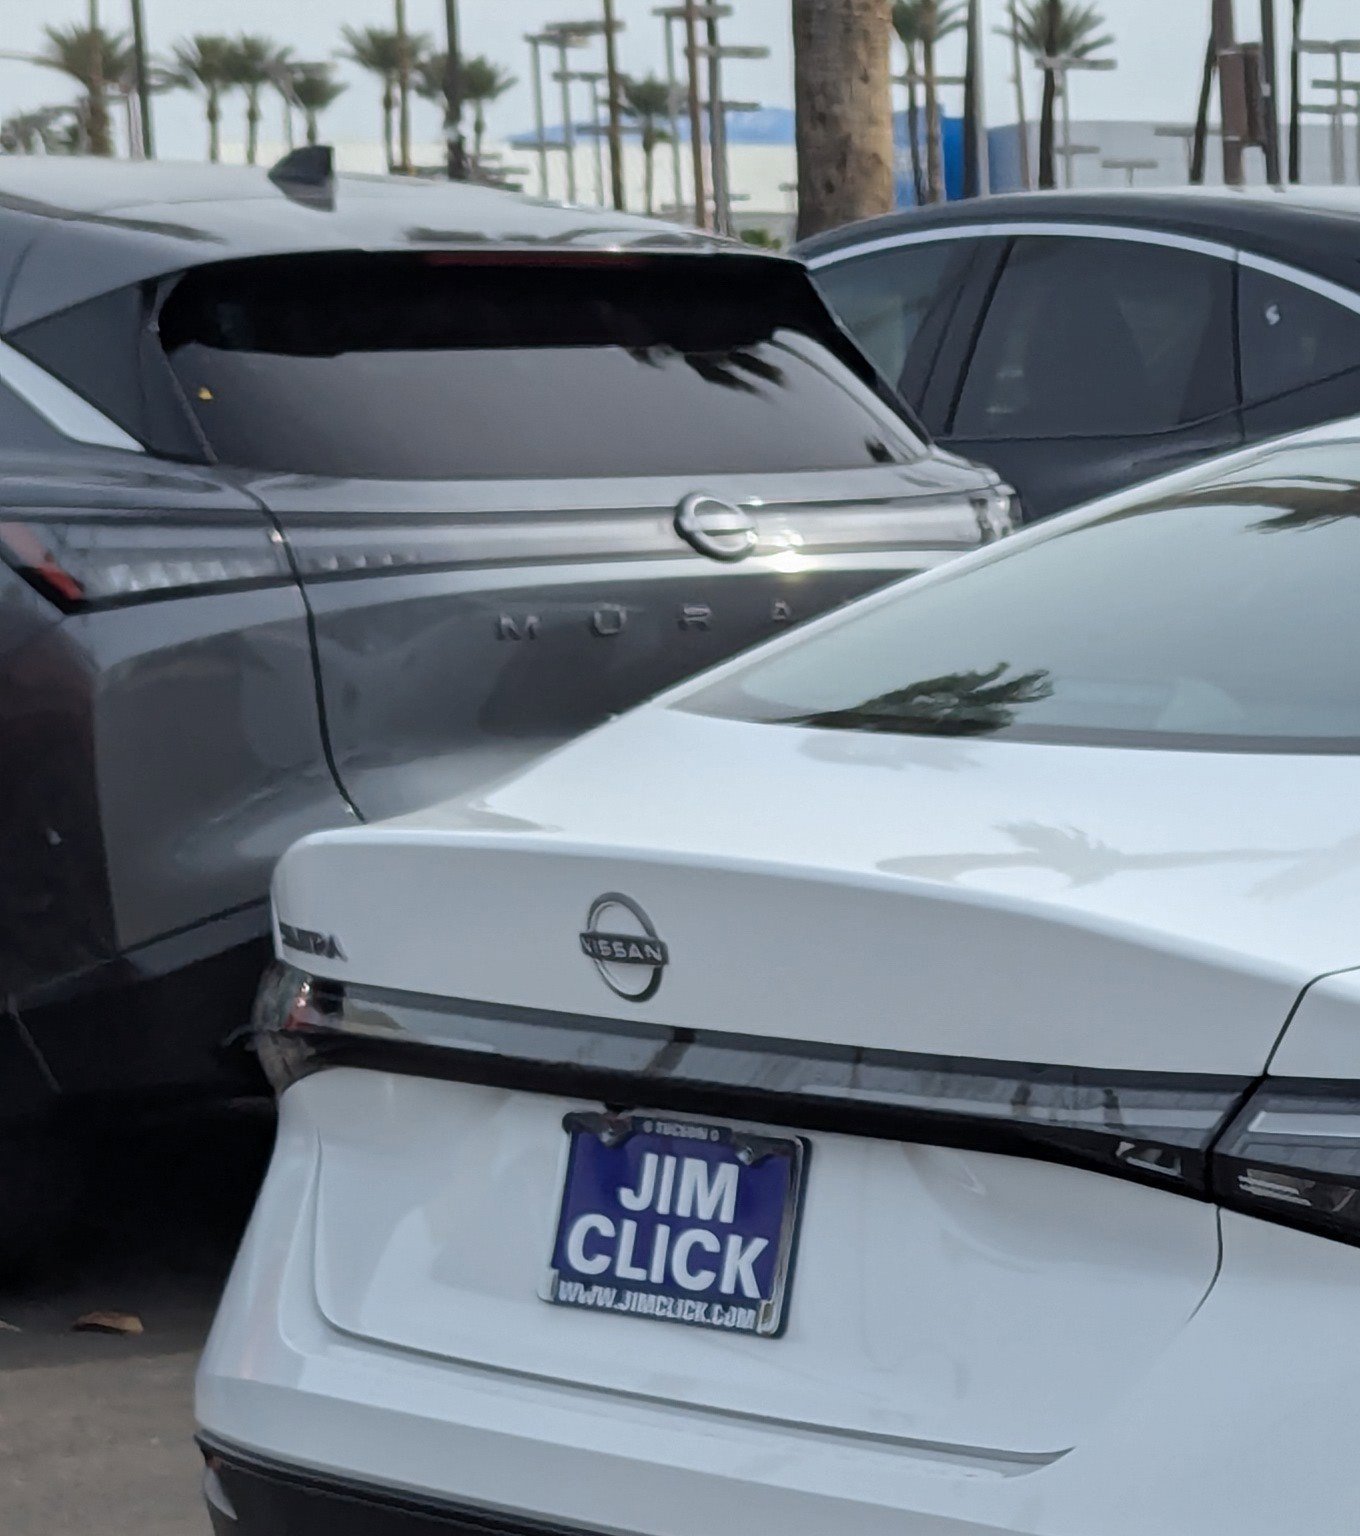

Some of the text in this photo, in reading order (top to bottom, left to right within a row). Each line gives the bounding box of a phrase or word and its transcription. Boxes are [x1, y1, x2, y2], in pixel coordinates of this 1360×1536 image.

[580, 936, 663, 961] NISSAN
[618, 1153, 740, 1224] JIM
[566, 1213, 770, 1299] CLICK
[558, 1281, 757, 1330] WWW.JIMCLICK.COM
